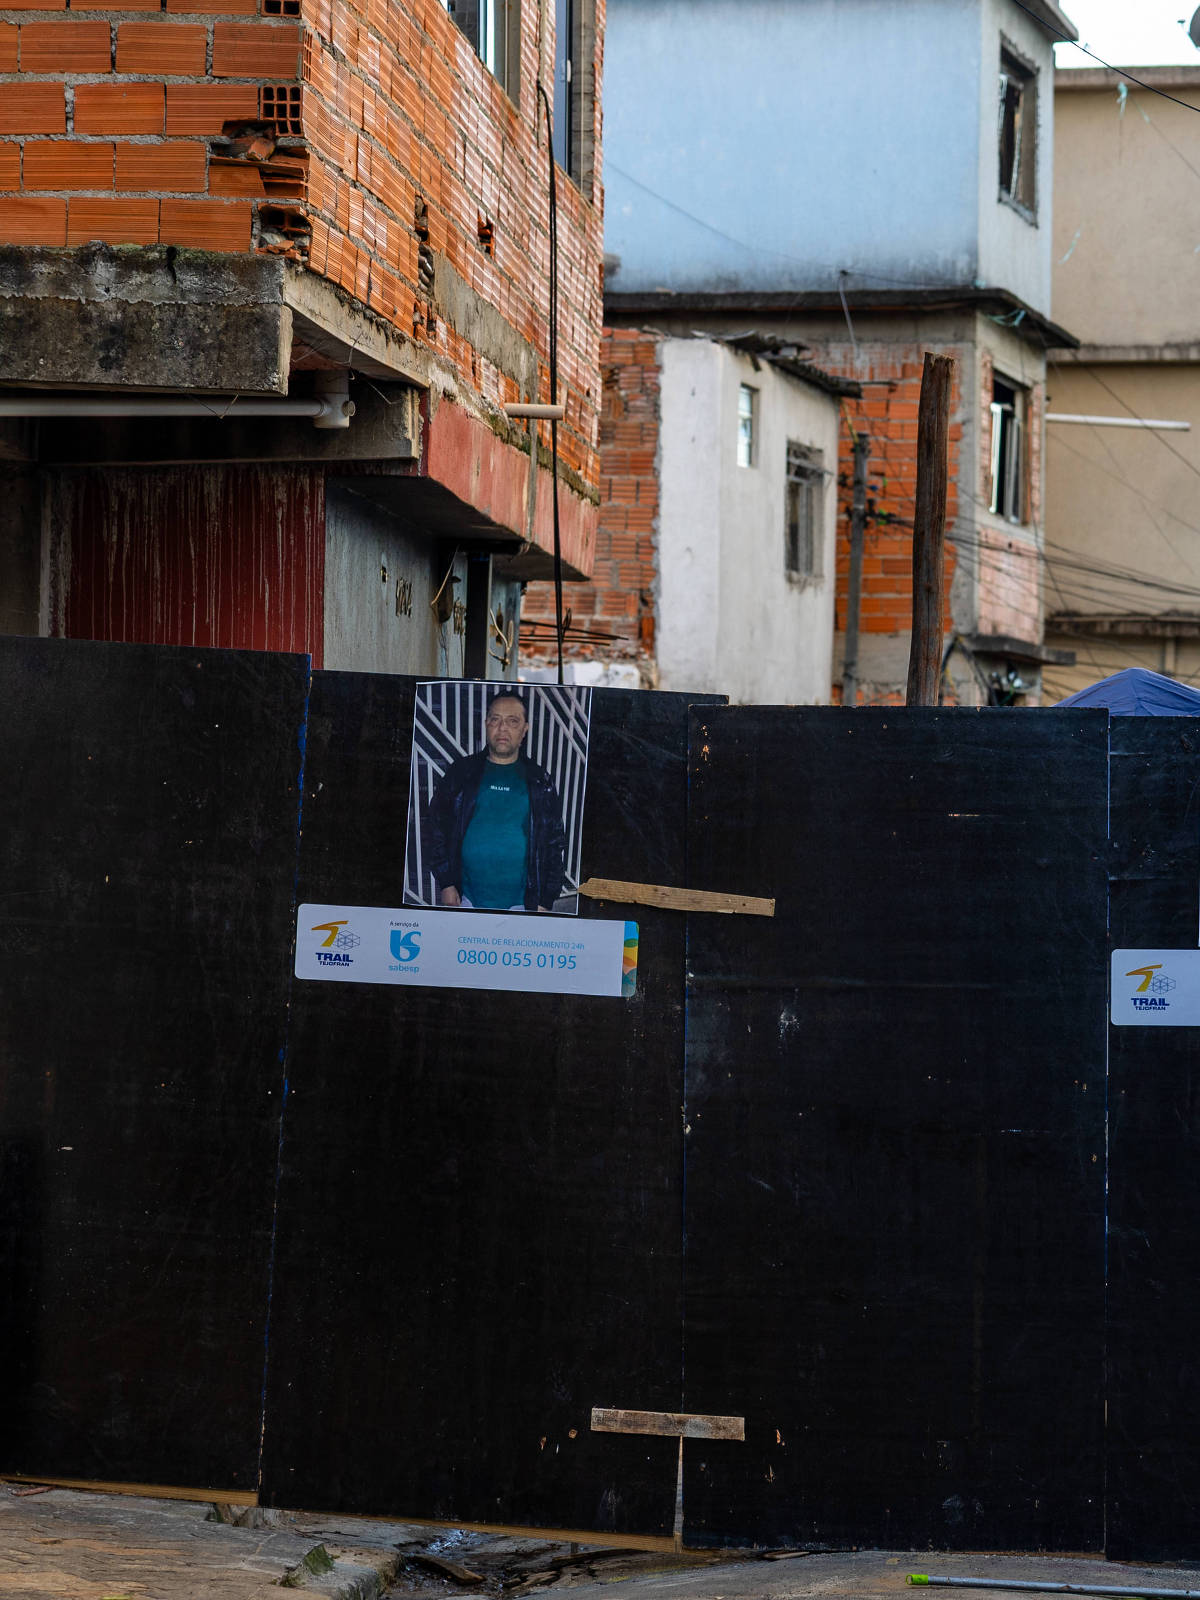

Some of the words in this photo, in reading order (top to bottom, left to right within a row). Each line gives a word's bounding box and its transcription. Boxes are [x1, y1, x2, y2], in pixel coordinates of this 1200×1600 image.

[458, 936, 490, 945] CENTRAL
[492, 938, 502, 946] DE
[503, 939, 570, 950] RELACIONAMENTO
[315, 952, 353, 963] TRAIL
[457, 949, 498, 966] 0800
[502, 951, 532, 967] 055
[536, 953, 577, 970] 0195
[388, 964, 420, 974] sabesp
[1130, 997, 1170, 1006] TRAIL
